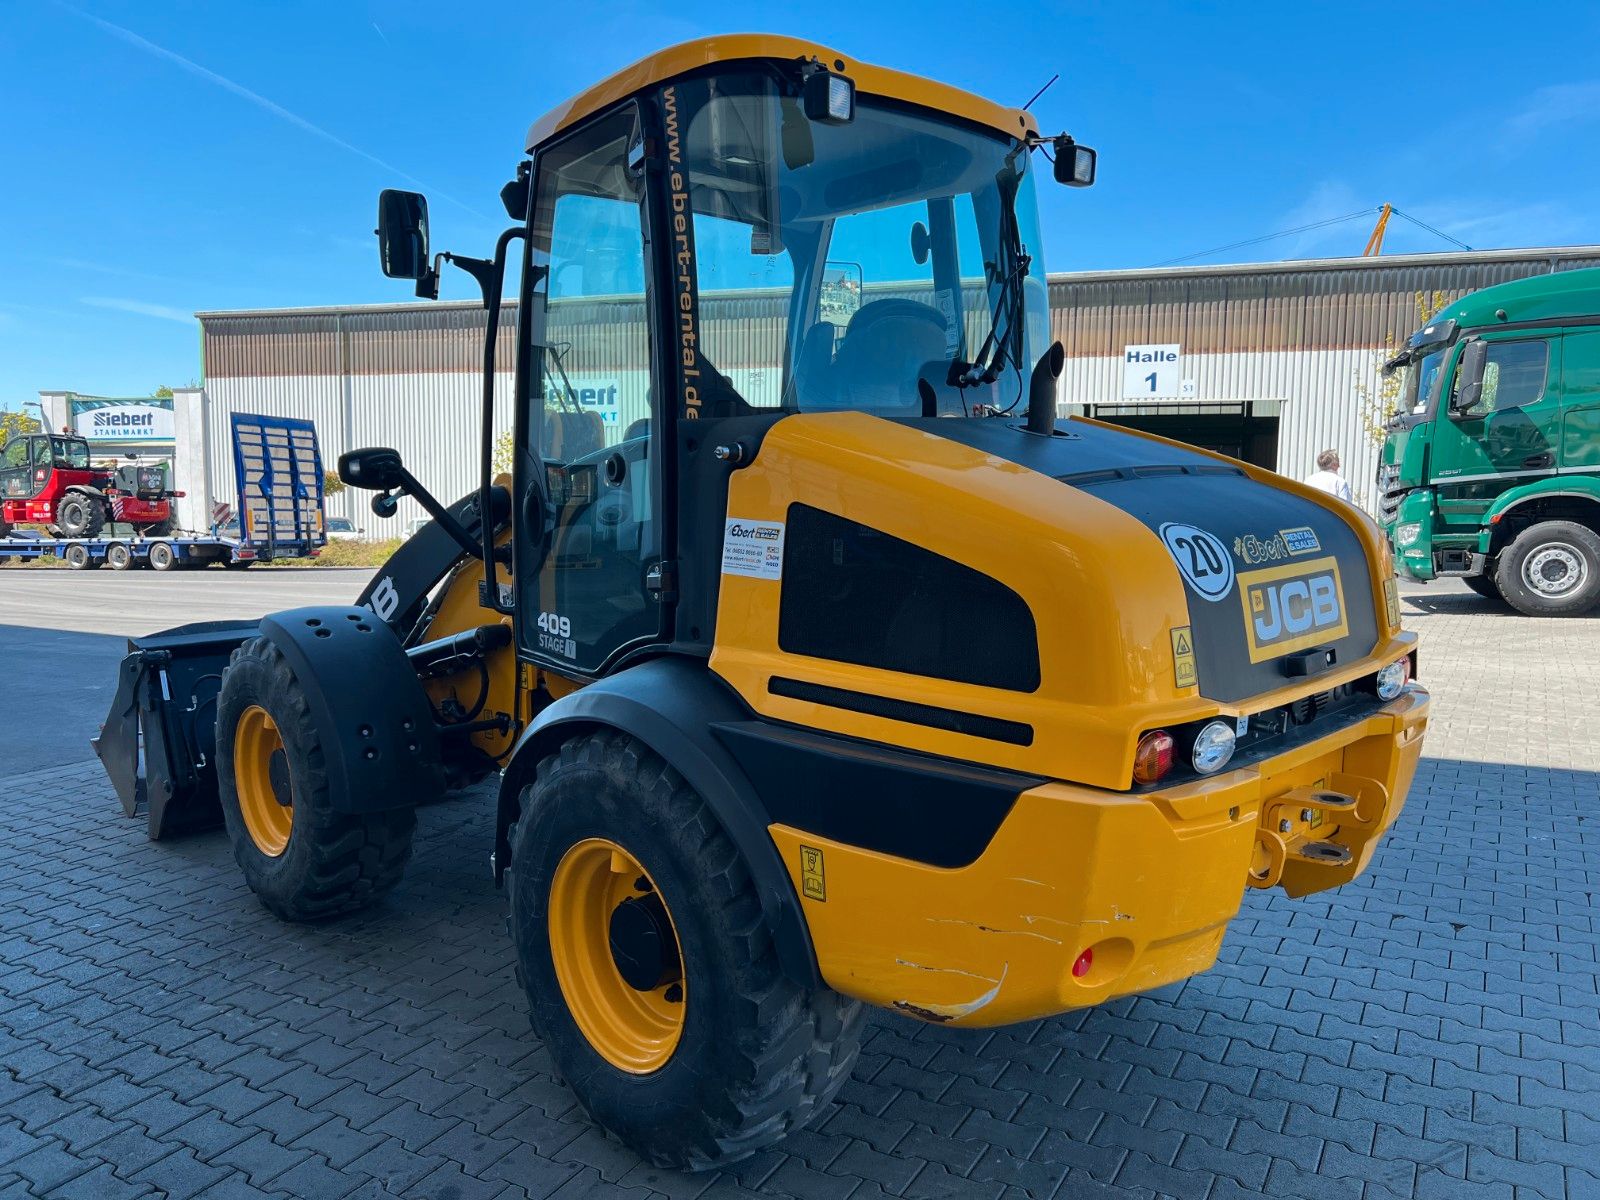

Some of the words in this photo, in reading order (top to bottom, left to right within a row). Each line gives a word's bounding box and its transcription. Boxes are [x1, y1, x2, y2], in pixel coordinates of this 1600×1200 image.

[664, 86, 702, 420] www.ebert-rental.de
[1127, 351, 1177, 363] Halle
[1145, 372, 1157, 392] 1
[94, 412, 154, 427] Siebert
[94, 428, 154, 436] STAHLMARKT
[732, 525, 755, 539] Ebert
[1284, 531, 1313, 541] RENTAL
[1175, 535, 1224, 578] 20
[1242, 535, 1288, 564] Ebert
[1255, 575, 1339, 641] JCB
[537, 612, 571, 638] 409
[539, 633, 564, 654] STAGE
